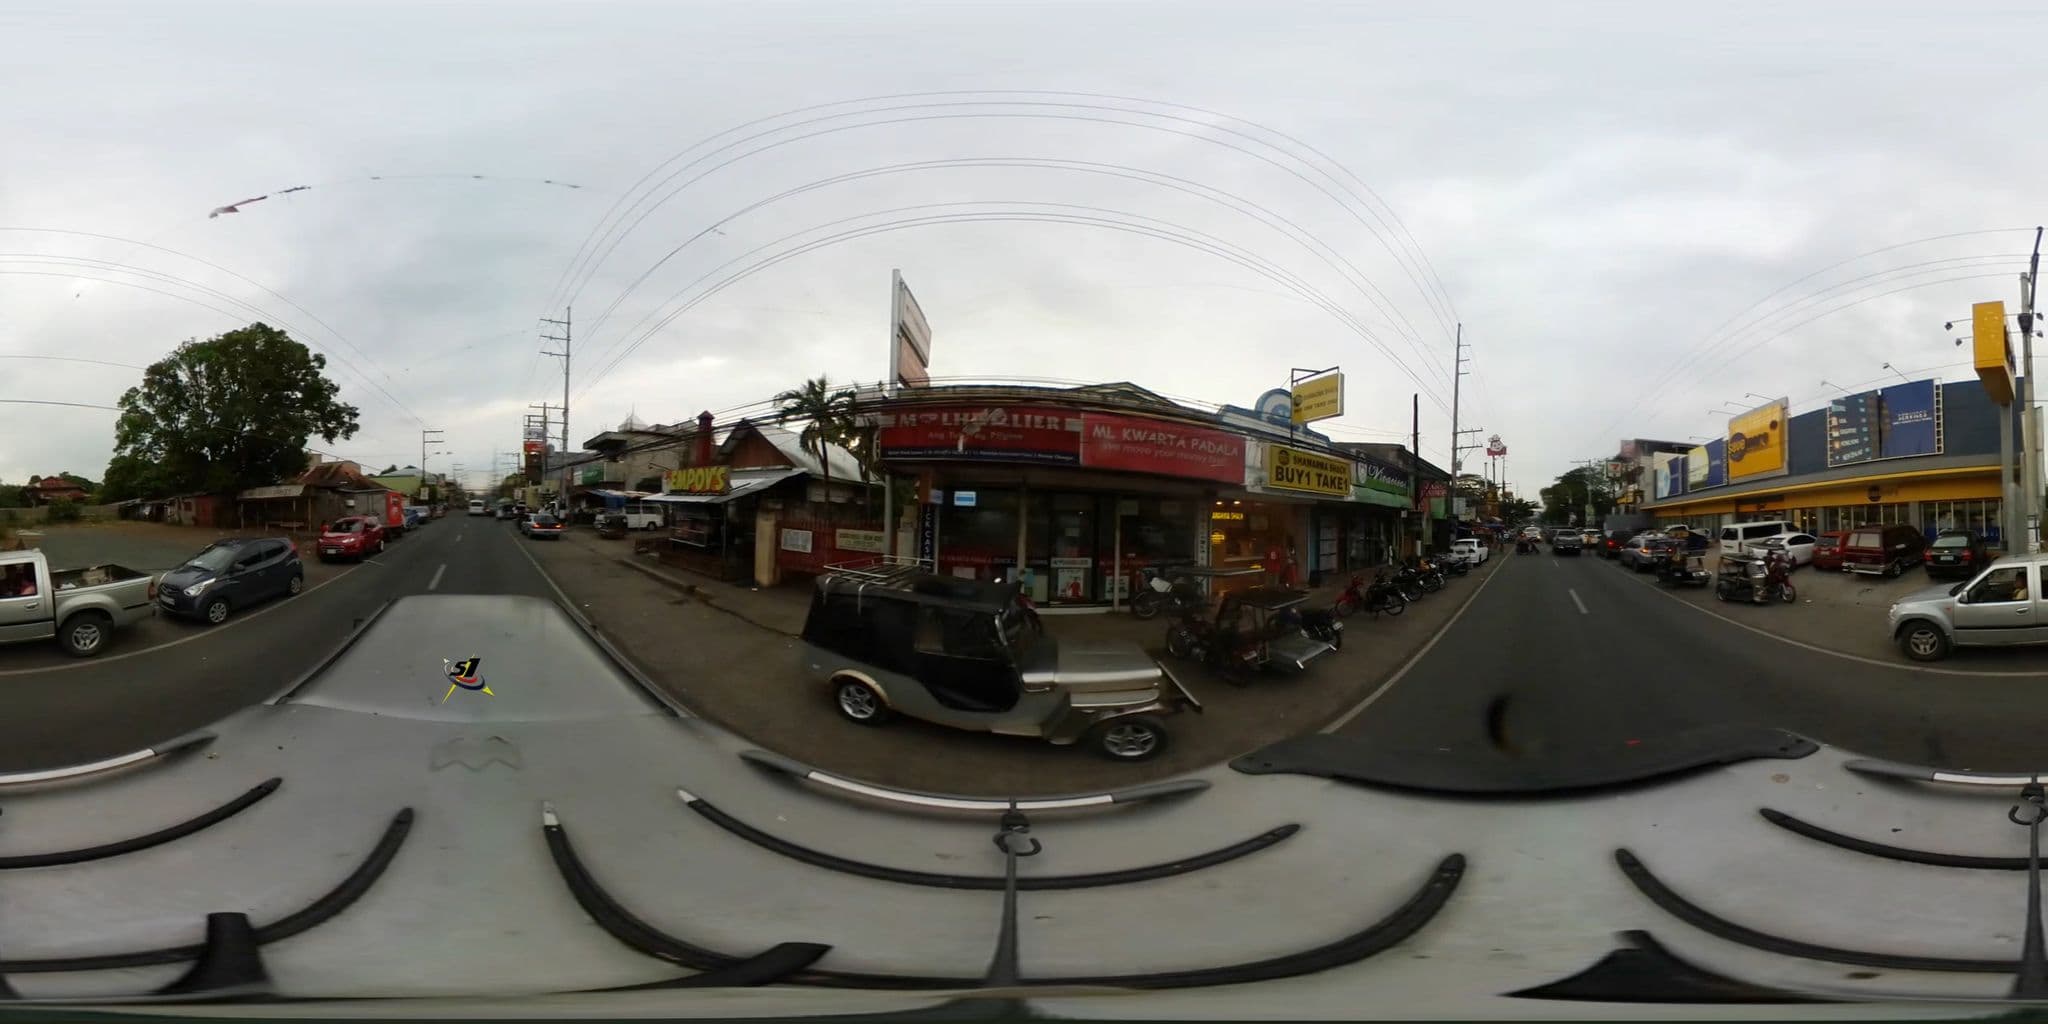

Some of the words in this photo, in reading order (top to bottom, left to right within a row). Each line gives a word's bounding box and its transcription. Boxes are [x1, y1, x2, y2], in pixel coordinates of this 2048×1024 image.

[1093, 425, 1115, 439] ML
[1122, 427, 1186, 448] KWARTA
[1191, 438, 1239, 457] PADALA
[1293, 454, 1329, 471] SHAWARMA
[1330, 462, 1347, 474] SHACK
[670, 466, 726, 490] EMPOY'S
